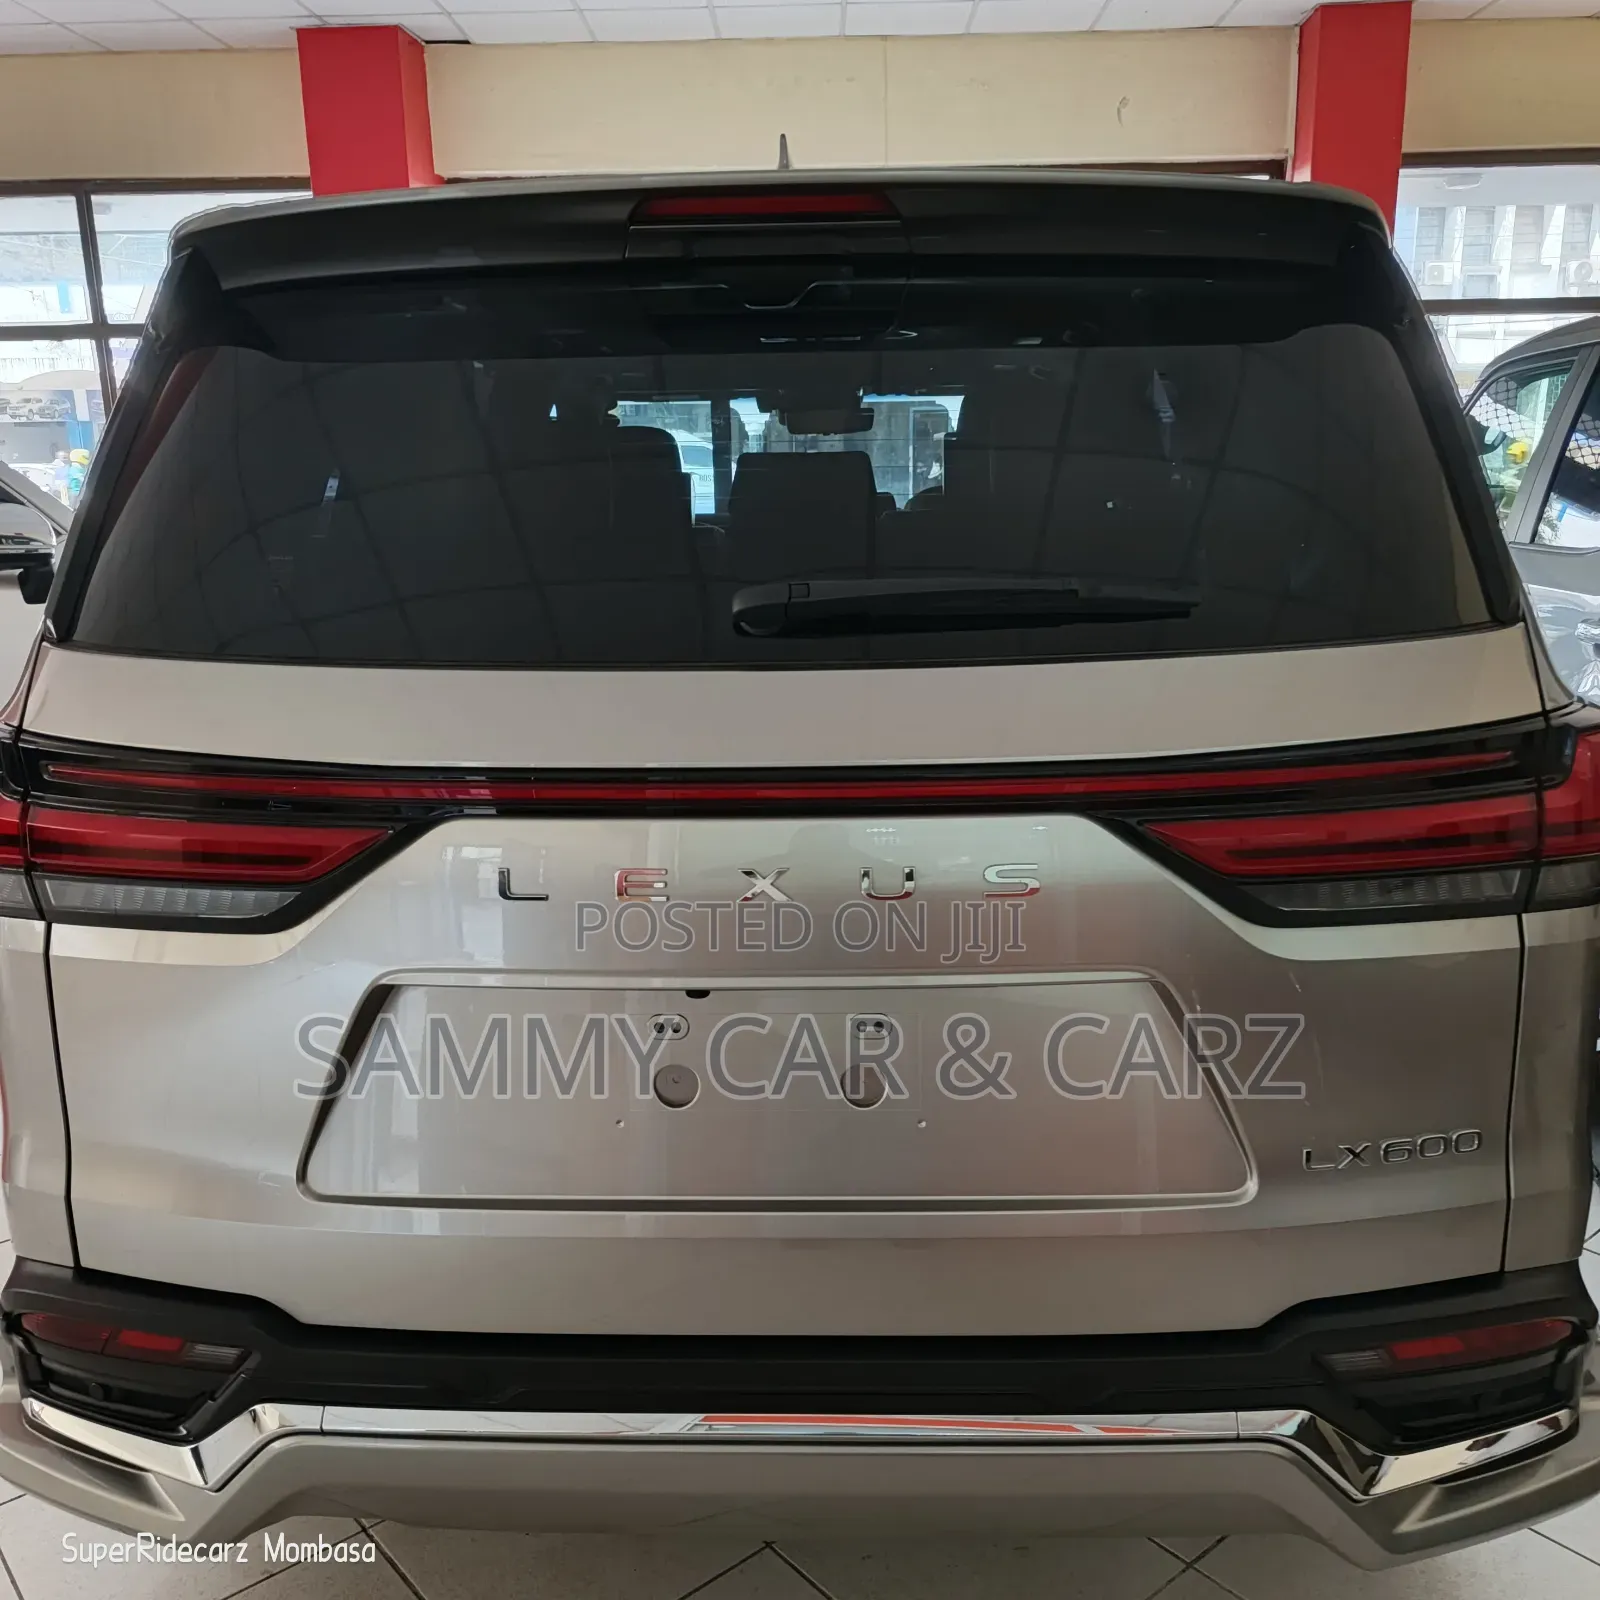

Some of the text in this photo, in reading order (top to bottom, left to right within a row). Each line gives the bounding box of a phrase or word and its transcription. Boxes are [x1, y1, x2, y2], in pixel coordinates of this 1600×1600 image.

[498, 863, 1041, 902] LEXUS
[1303, 1129, 1483, 1171] LX 600
